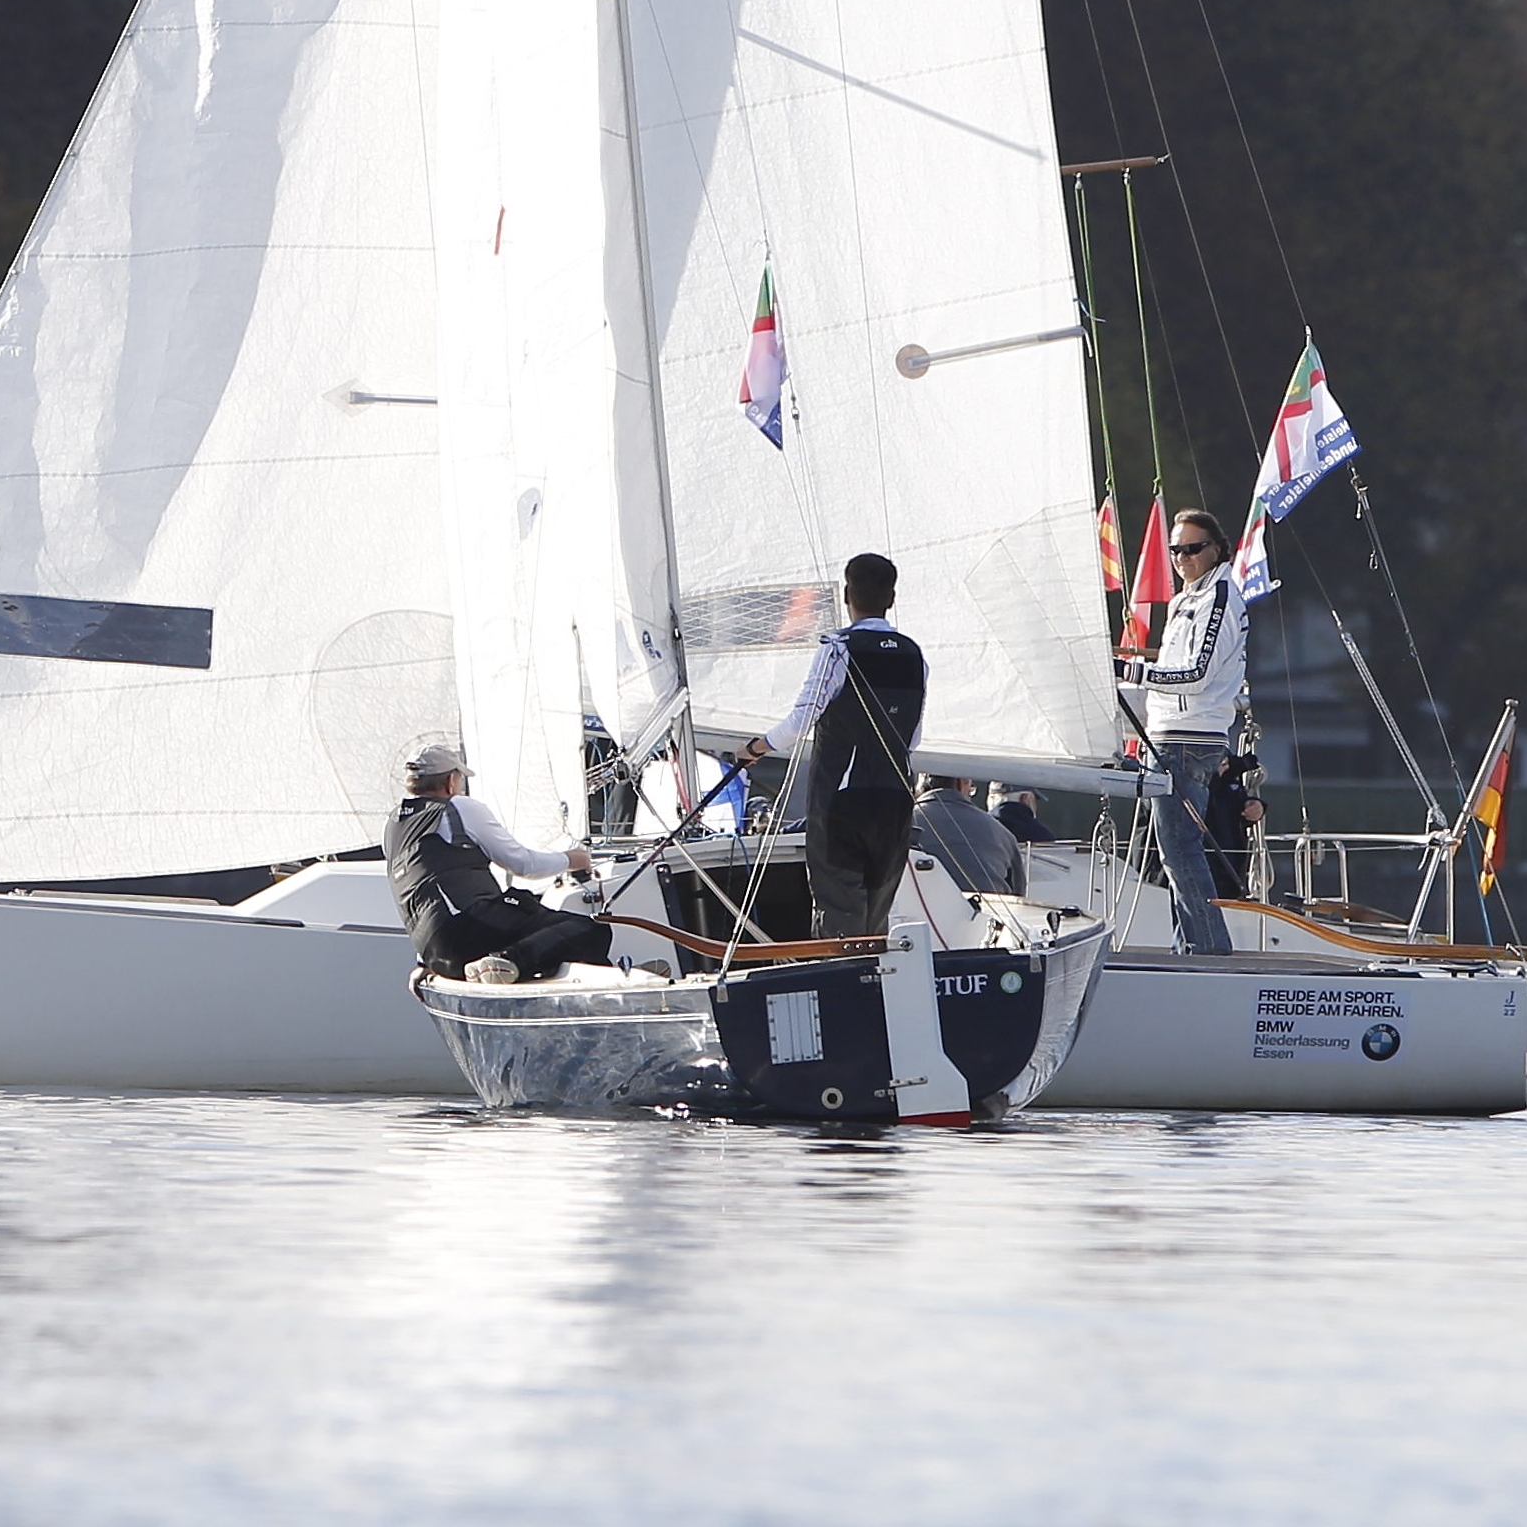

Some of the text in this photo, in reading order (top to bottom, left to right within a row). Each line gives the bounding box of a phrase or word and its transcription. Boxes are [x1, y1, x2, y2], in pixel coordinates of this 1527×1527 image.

[1258, 989, 1396, 1004] FREUDE AM SPORT.
[1257, 1003, 1404, 1018] FREUDE AM FAHREN.
[1256, 1020, 1295, 1033] BMW
[1254, 1034, 1351, 1050] Niederlassung
[1253, 1047, 1294, 1059] Essen
